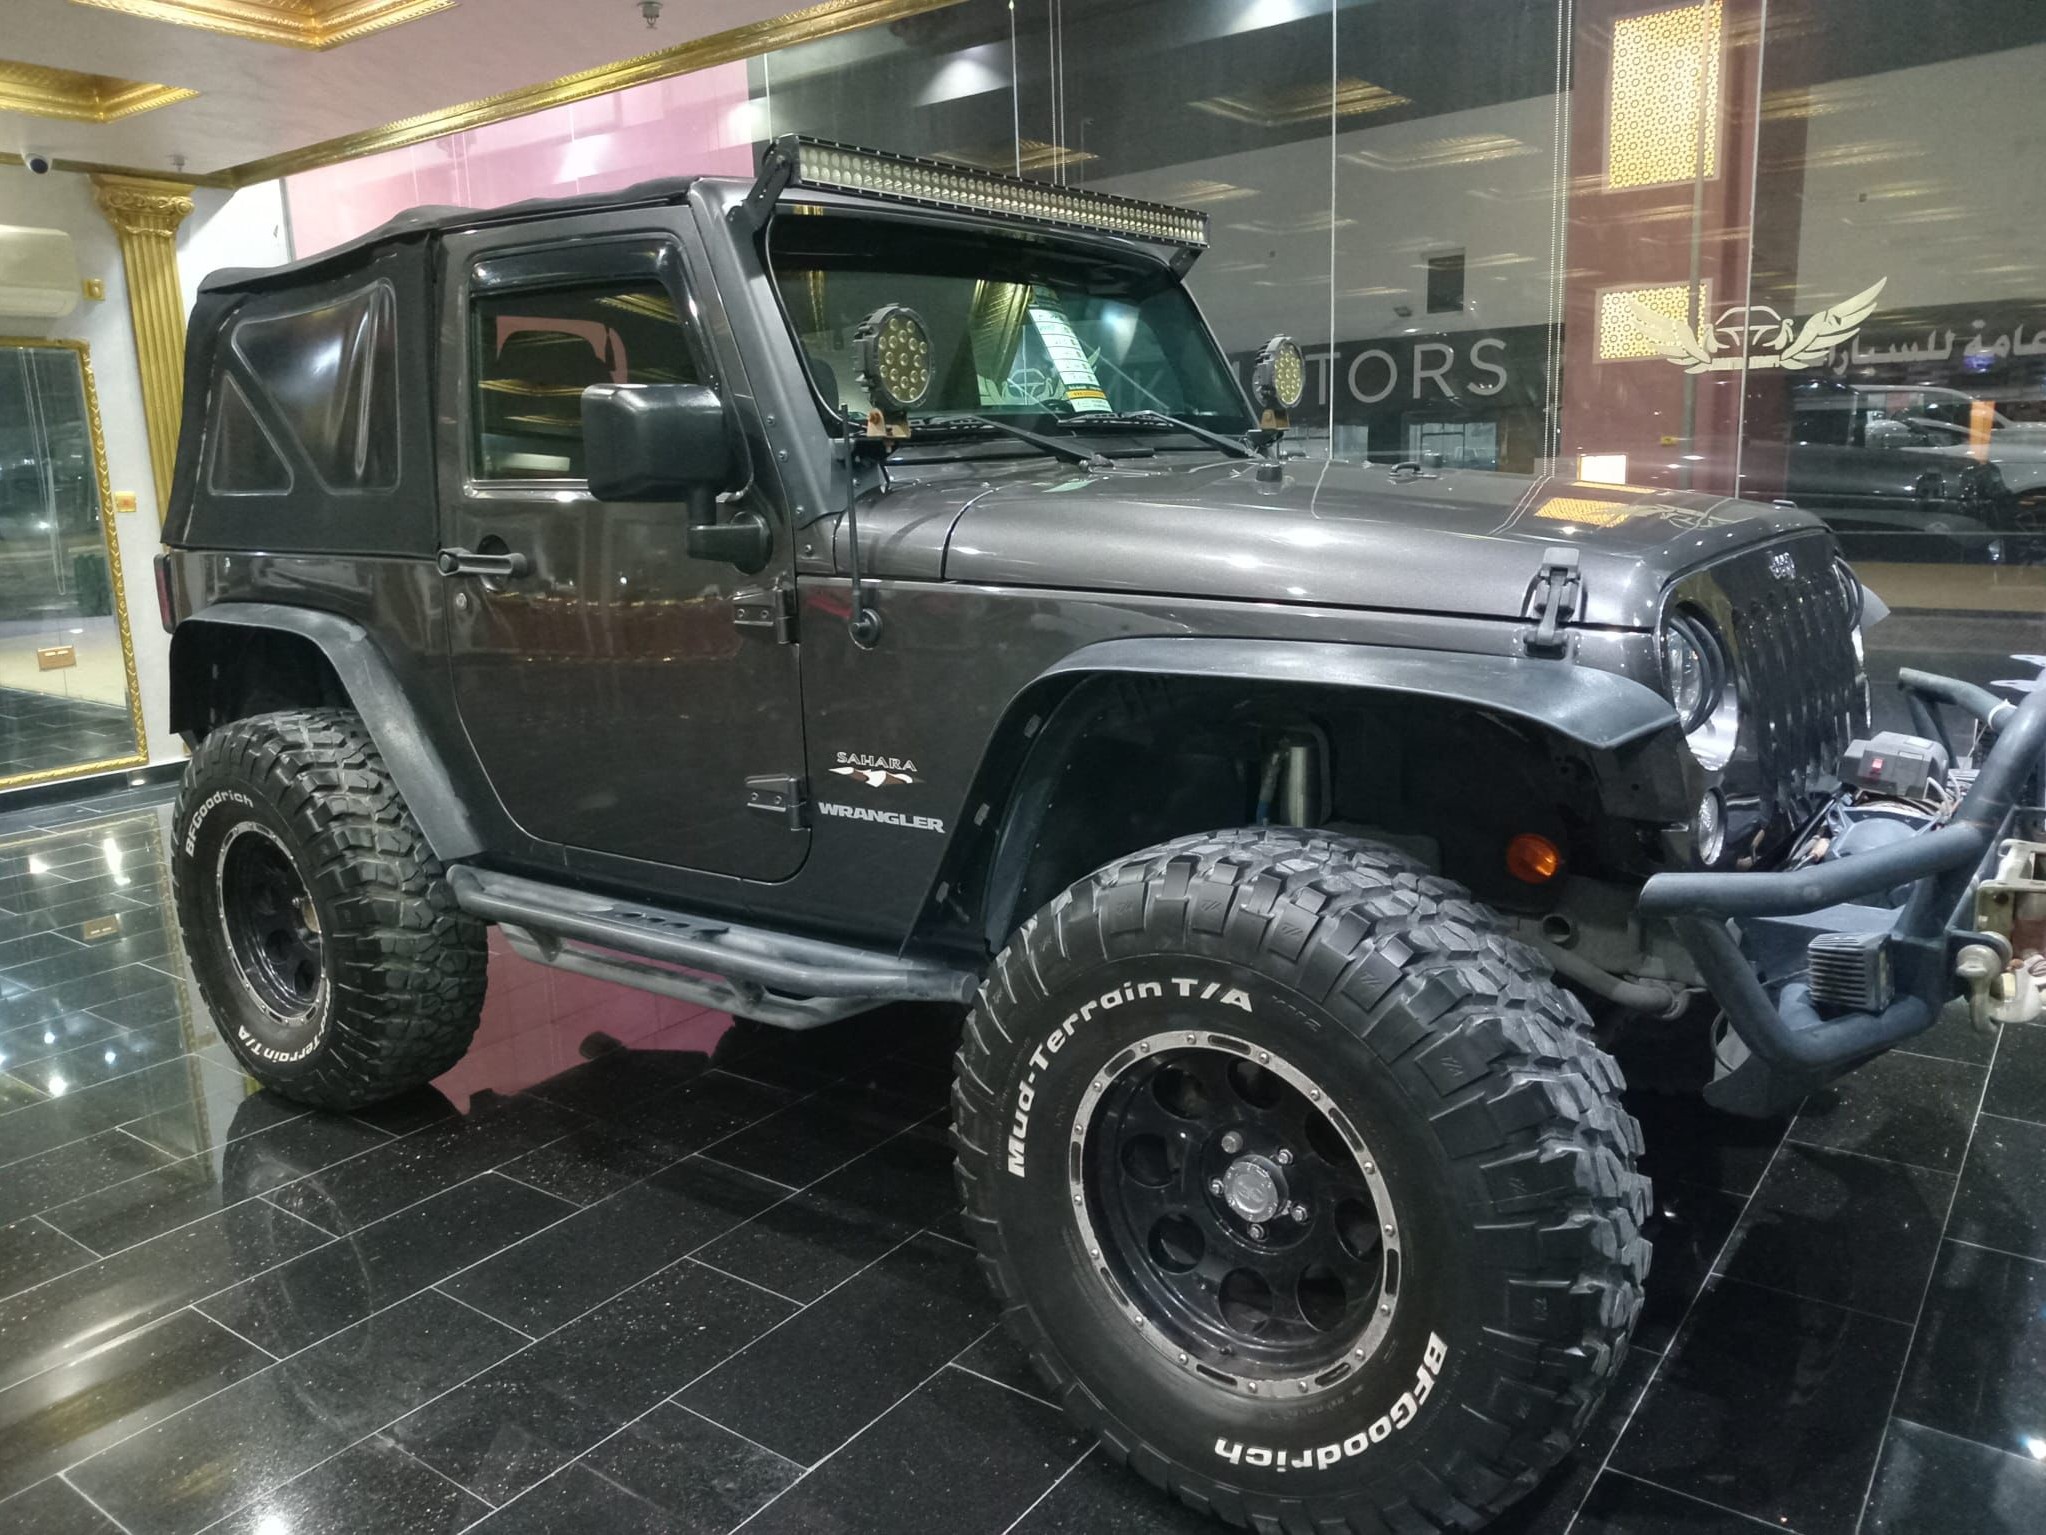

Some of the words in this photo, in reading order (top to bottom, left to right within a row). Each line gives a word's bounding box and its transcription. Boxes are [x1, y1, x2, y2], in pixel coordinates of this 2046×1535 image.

[1232, 338, 1508, 406] TORS
[837, 751, 917, 772] SAHARA
[186, 790, 254, 857] BFGoodrich
[818, 801, 946, 834] WRANGLER
[1007, 981, 1163, 1178] Mud-Terrain
[1171, 977, 1253, 1013] T/A
[1214, 1330, 1449, 1473] BFGoodrich
